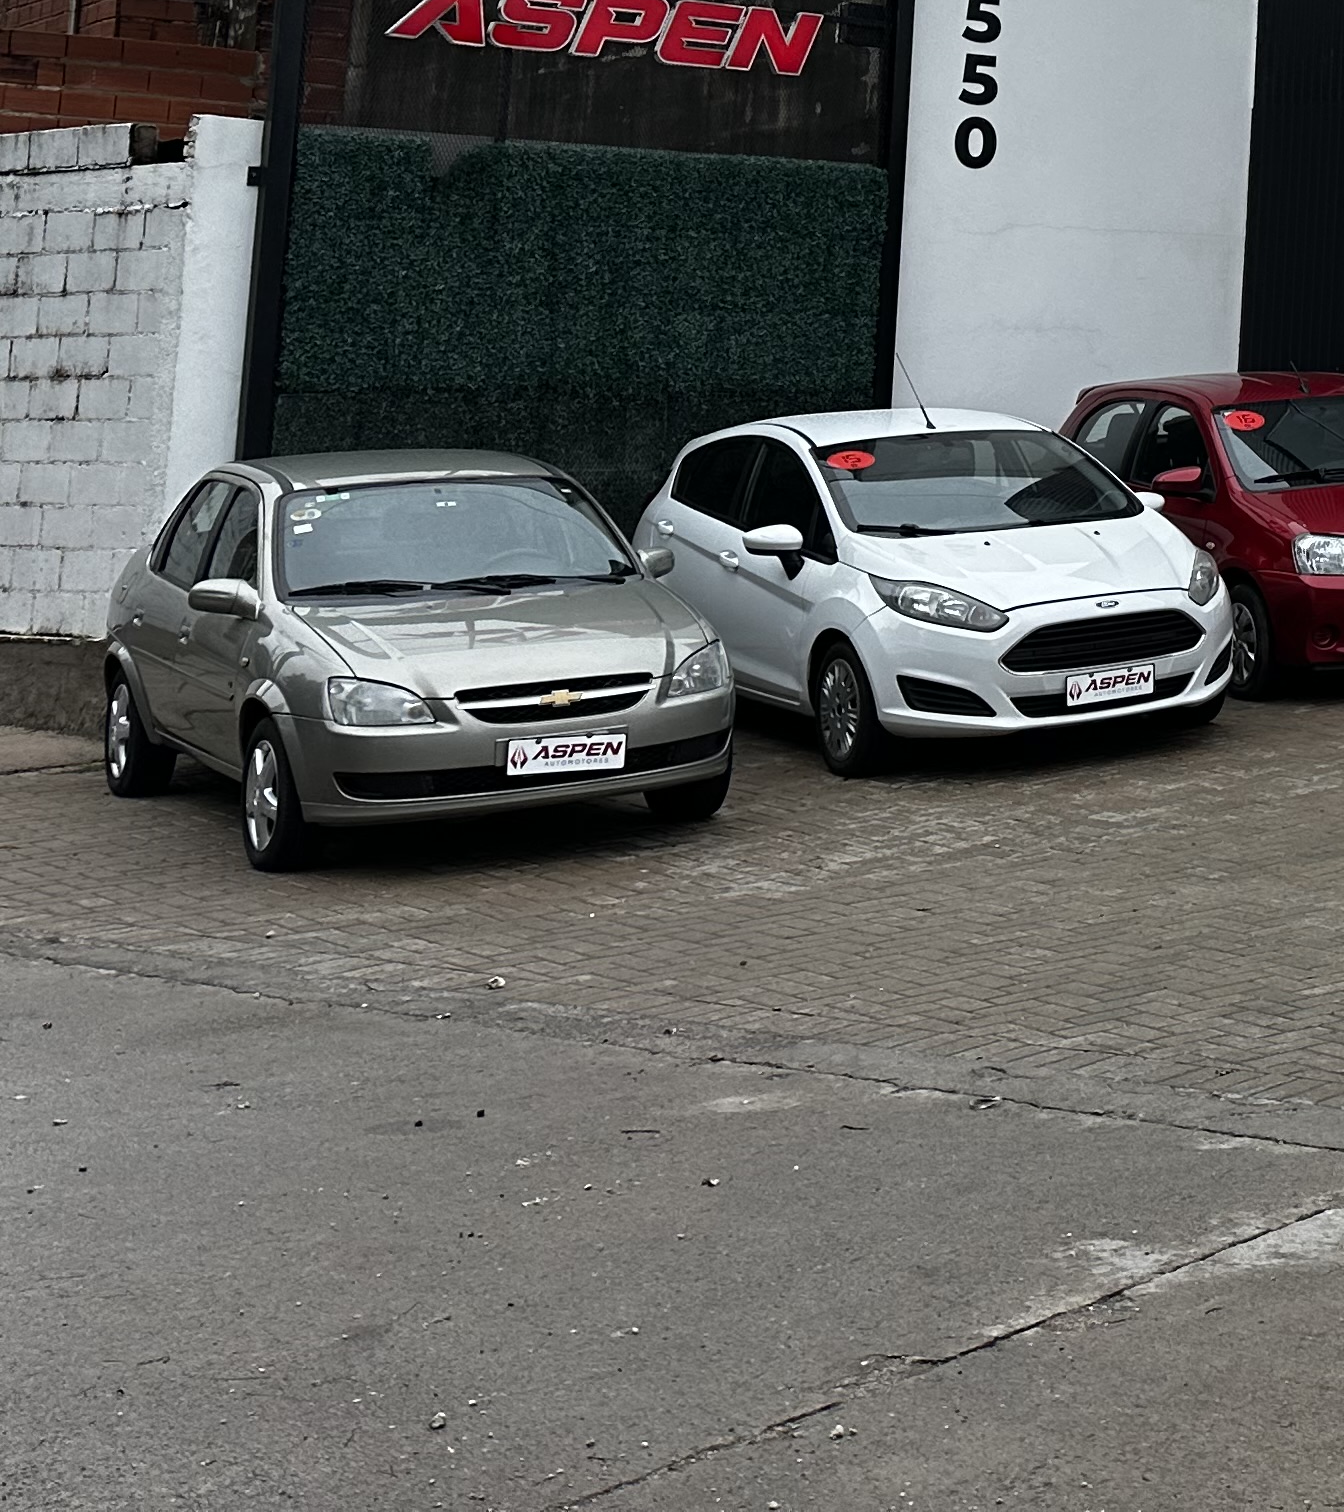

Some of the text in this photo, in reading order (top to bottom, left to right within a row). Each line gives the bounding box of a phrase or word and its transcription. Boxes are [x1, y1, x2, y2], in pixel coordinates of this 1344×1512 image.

[1084, 670, 1152, 692] ASPEN
[531, 740, 624, 760] ASPEN
[544, 757, 609, 767] AUTOMOTORES
